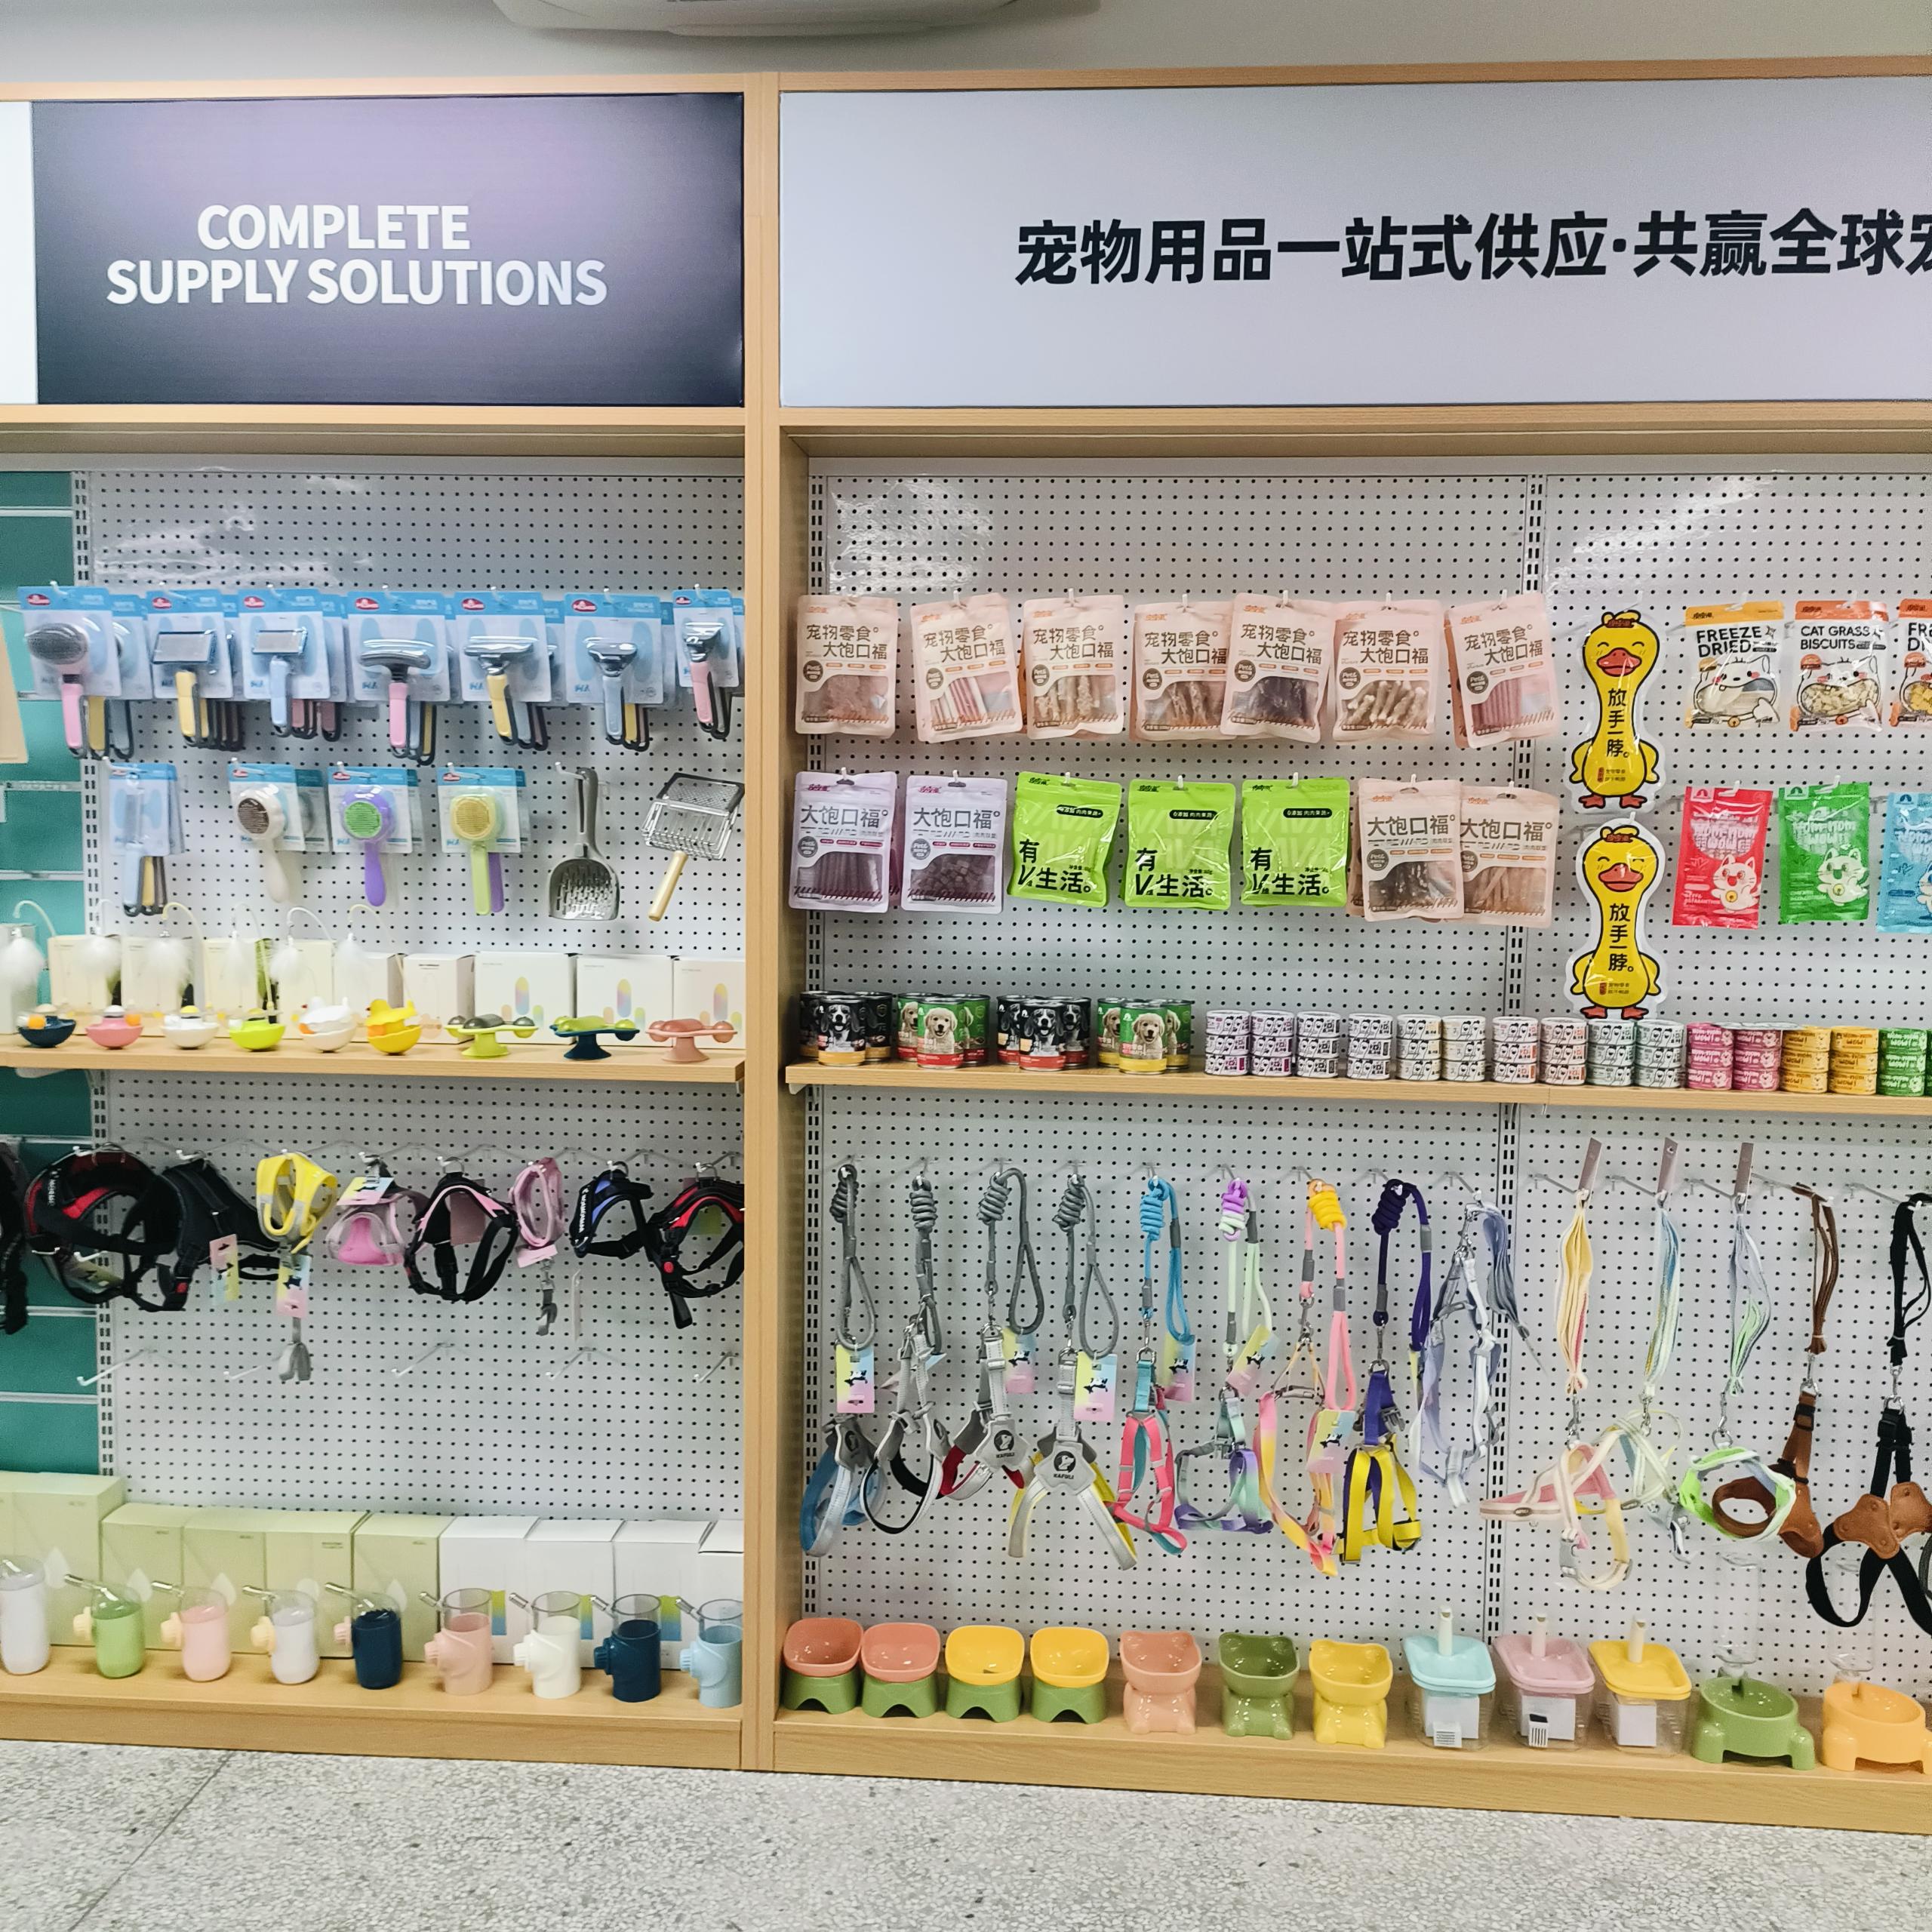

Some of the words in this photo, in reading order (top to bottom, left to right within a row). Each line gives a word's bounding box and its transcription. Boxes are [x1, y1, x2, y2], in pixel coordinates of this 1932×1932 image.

[197, 205, 470, 251] COMPLETE
[106, 258, 299, 305] SUPPLY
[306, 258, 608, 306] SOLUTIONS
[1696, 626, 1762, 644] FREEZE
[1801, 626, 1825, 636] CAT
[1828, 626, 1871, 637] GRASS
[823, 641, 888, 660] 大饱口福
[940, 638, 1006, 663] 大饱口福
[1049, 641, 1114, 660] 大饱口福
[1257, 641, 1322, 665] 大饱口福
[1484, 640, 1543, 666] 大饱口福
[1697, 639, 1752, 657] DRIED
[1800, 638, 1856, 650] BISCUITS
[1161, 648, 1227, 665] 大饱口福
[1360, 648, 1429, 664] 大饱口福
[1019, 838, 1040, 863] 有
[1134, 847, 1158, 872] 有
[1250, 847, 1273, 872] 有
